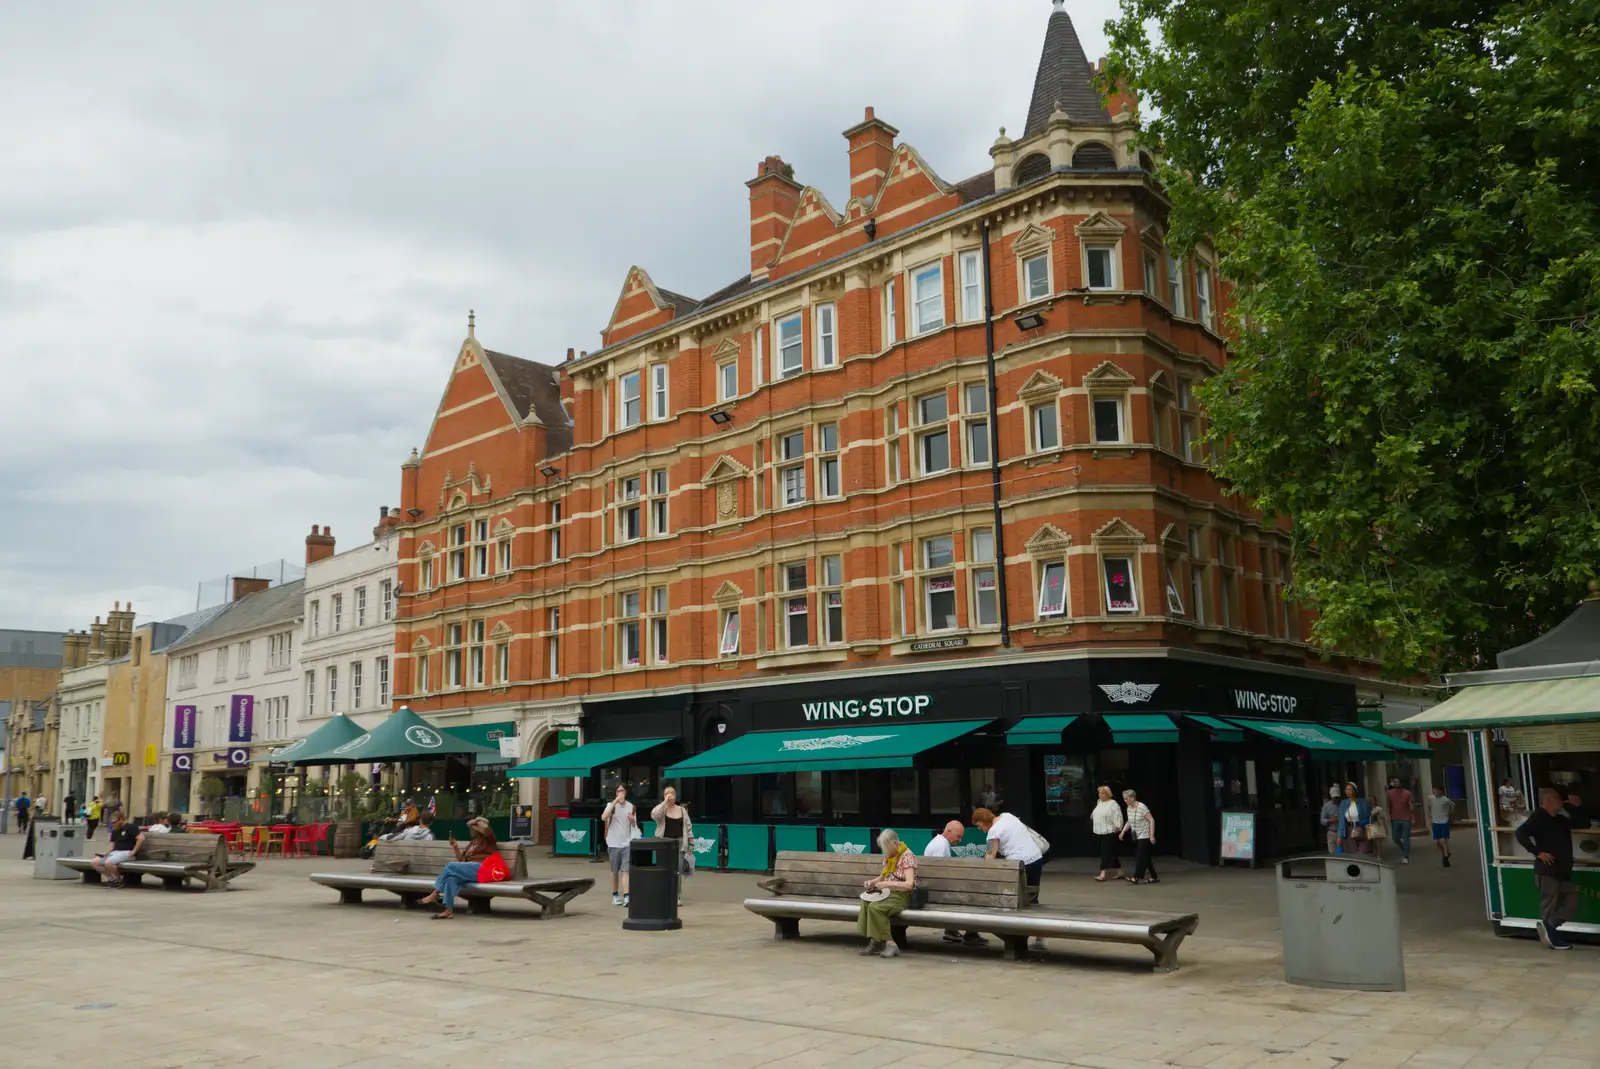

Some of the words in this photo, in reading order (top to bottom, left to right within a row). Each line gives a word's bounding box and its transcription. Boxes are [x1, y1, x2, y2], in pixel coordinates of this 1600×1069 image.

[913, 641, 943, 650] CATHEDRAL
[944, 639, 965, 647] SQUARE
[237, 698, 248, 737] Queensgate
[181, 708, 191, 744] Queensgate
[175, 755, 191, 770] Q
[232, 749, 248, 765] Q
